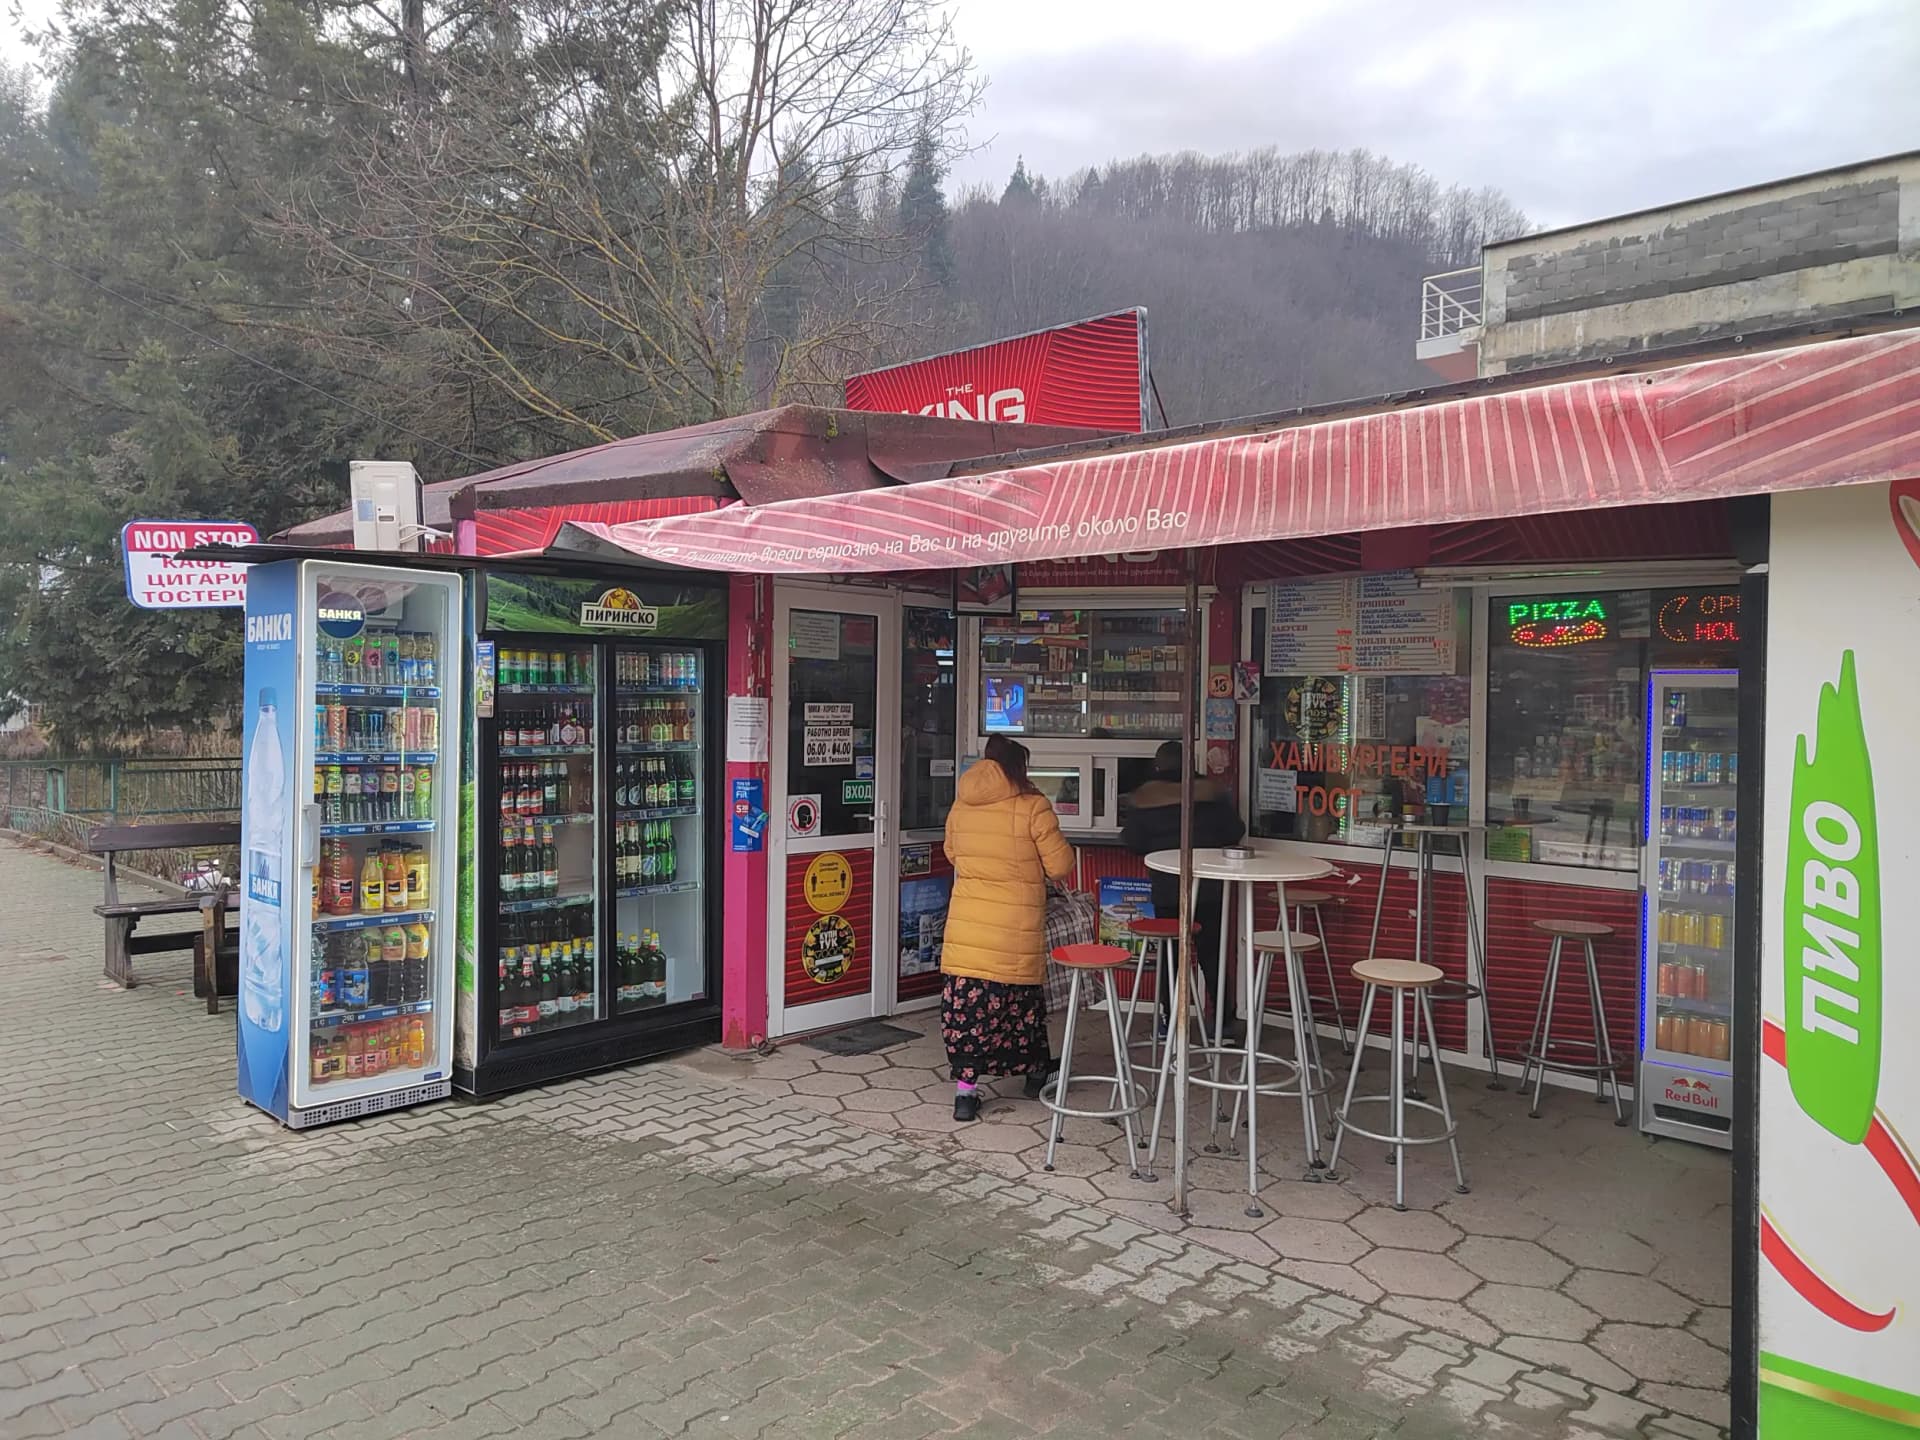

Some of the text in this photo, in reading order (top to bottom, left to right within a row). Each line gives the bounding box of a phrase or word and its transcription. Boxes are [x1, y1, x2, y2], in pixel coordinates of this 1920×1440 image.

[946, 384, 974, 396] THE
[902, 388, 1025, 424] NG
[134, 530, 253, 549] NON STOP
[807, 542, 879, 561] сериозно
[884, 540, 904, 554] на
[909, 534, 941, 553] Вас
[945, 536, 957, 551] и
[961, 533, 982, 549] на
[987, 523, 1071, 552] другите
[1077, 515, 1139, 537] около
[1146, 508, 1188, 530] Вас
[147, 573, 247, 587] ЦИГАРИ
[318, 608, 361, 620] БАНКЯ
[586, 609, 656, 625] ПИРИНСКО
[1508, 600, 1607, 625] PIZZA
[247, 613, 292, 643] БАНКЯ
[806, 743, 827, 756] 06.00
[845, 784, 872, 800] ВХОД
[1294, 785, 1364, 818] ТОСТ
[251, 876, 278, 899] БАНКЯ
[1801, 799, 1863, 1046] ПИВО
[819, 937, 839, 950] ТУК
[1665, 1088, 1718, 1109] Red Bull
